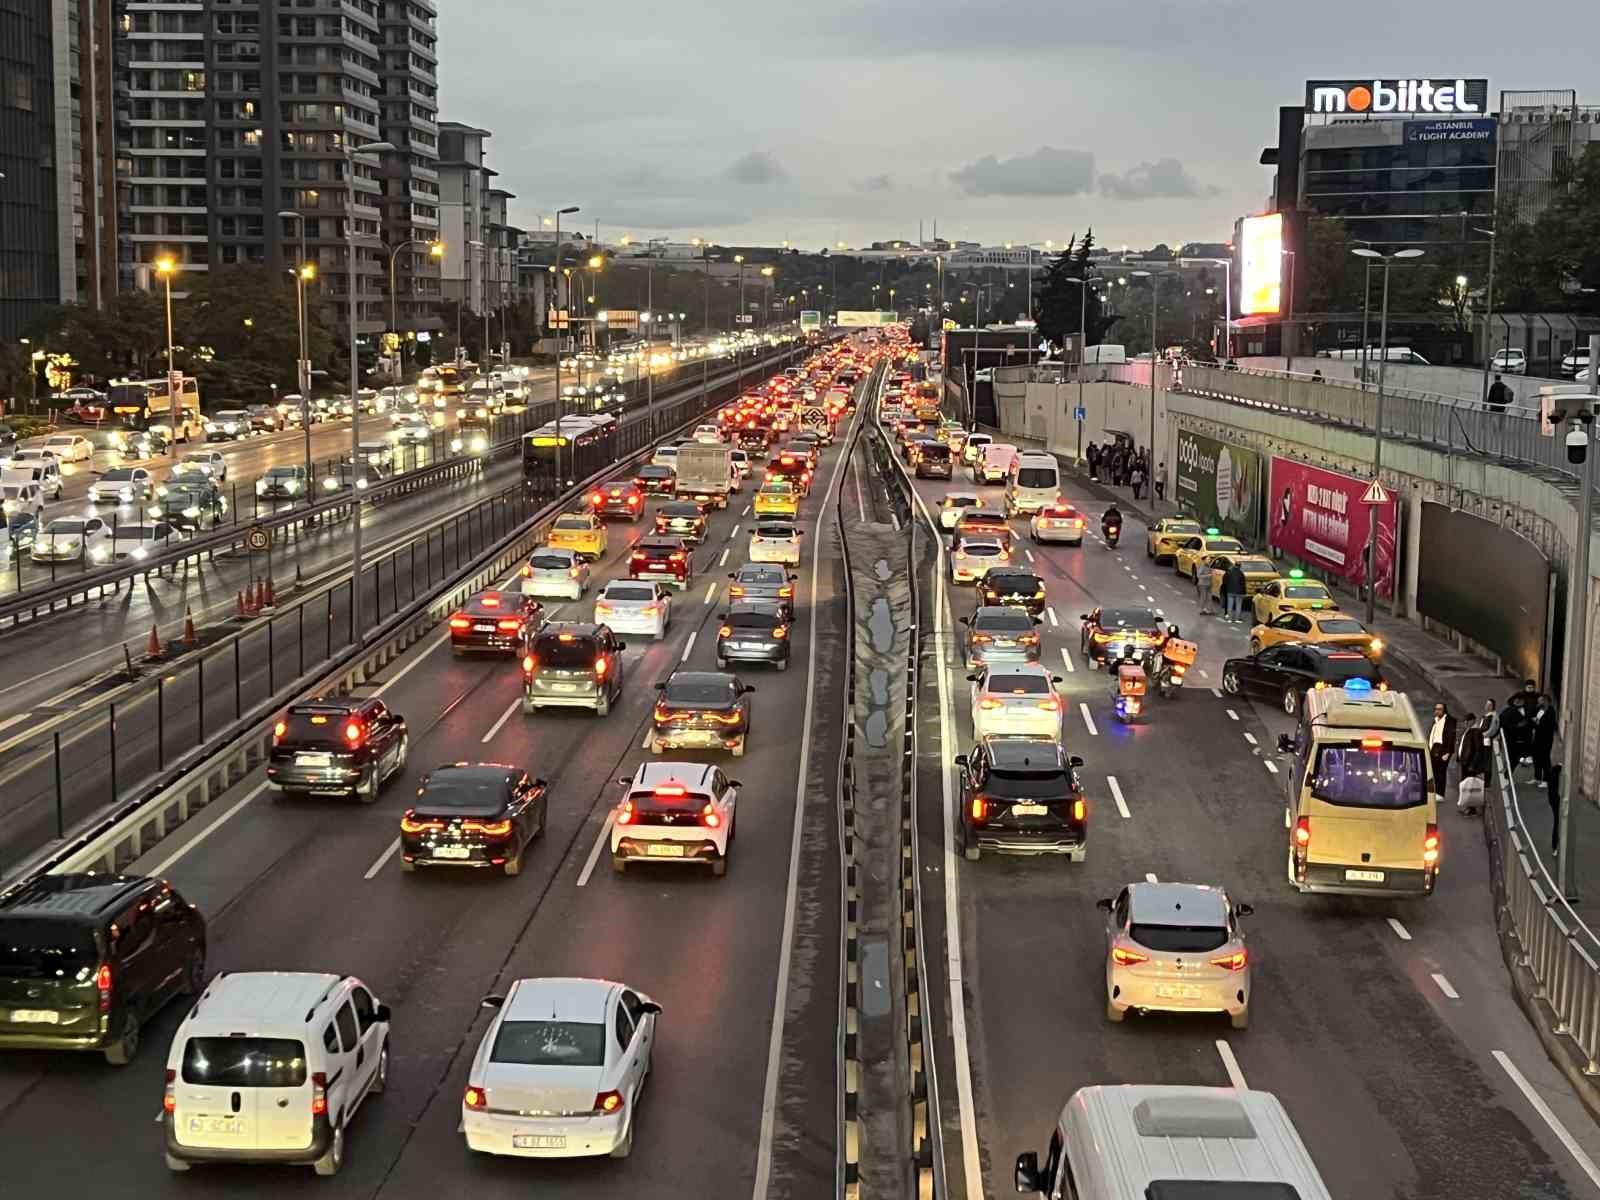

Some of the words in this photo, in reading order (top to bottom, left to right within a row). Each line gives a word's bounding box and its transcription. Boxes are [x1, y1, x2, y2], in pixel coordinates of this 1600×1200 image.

[1313, 80, 1478, 112] mobiltel
[1419, 132, 1447, 141] FLIGHT
[1449, 131, 1489, 140] ACADEMY
